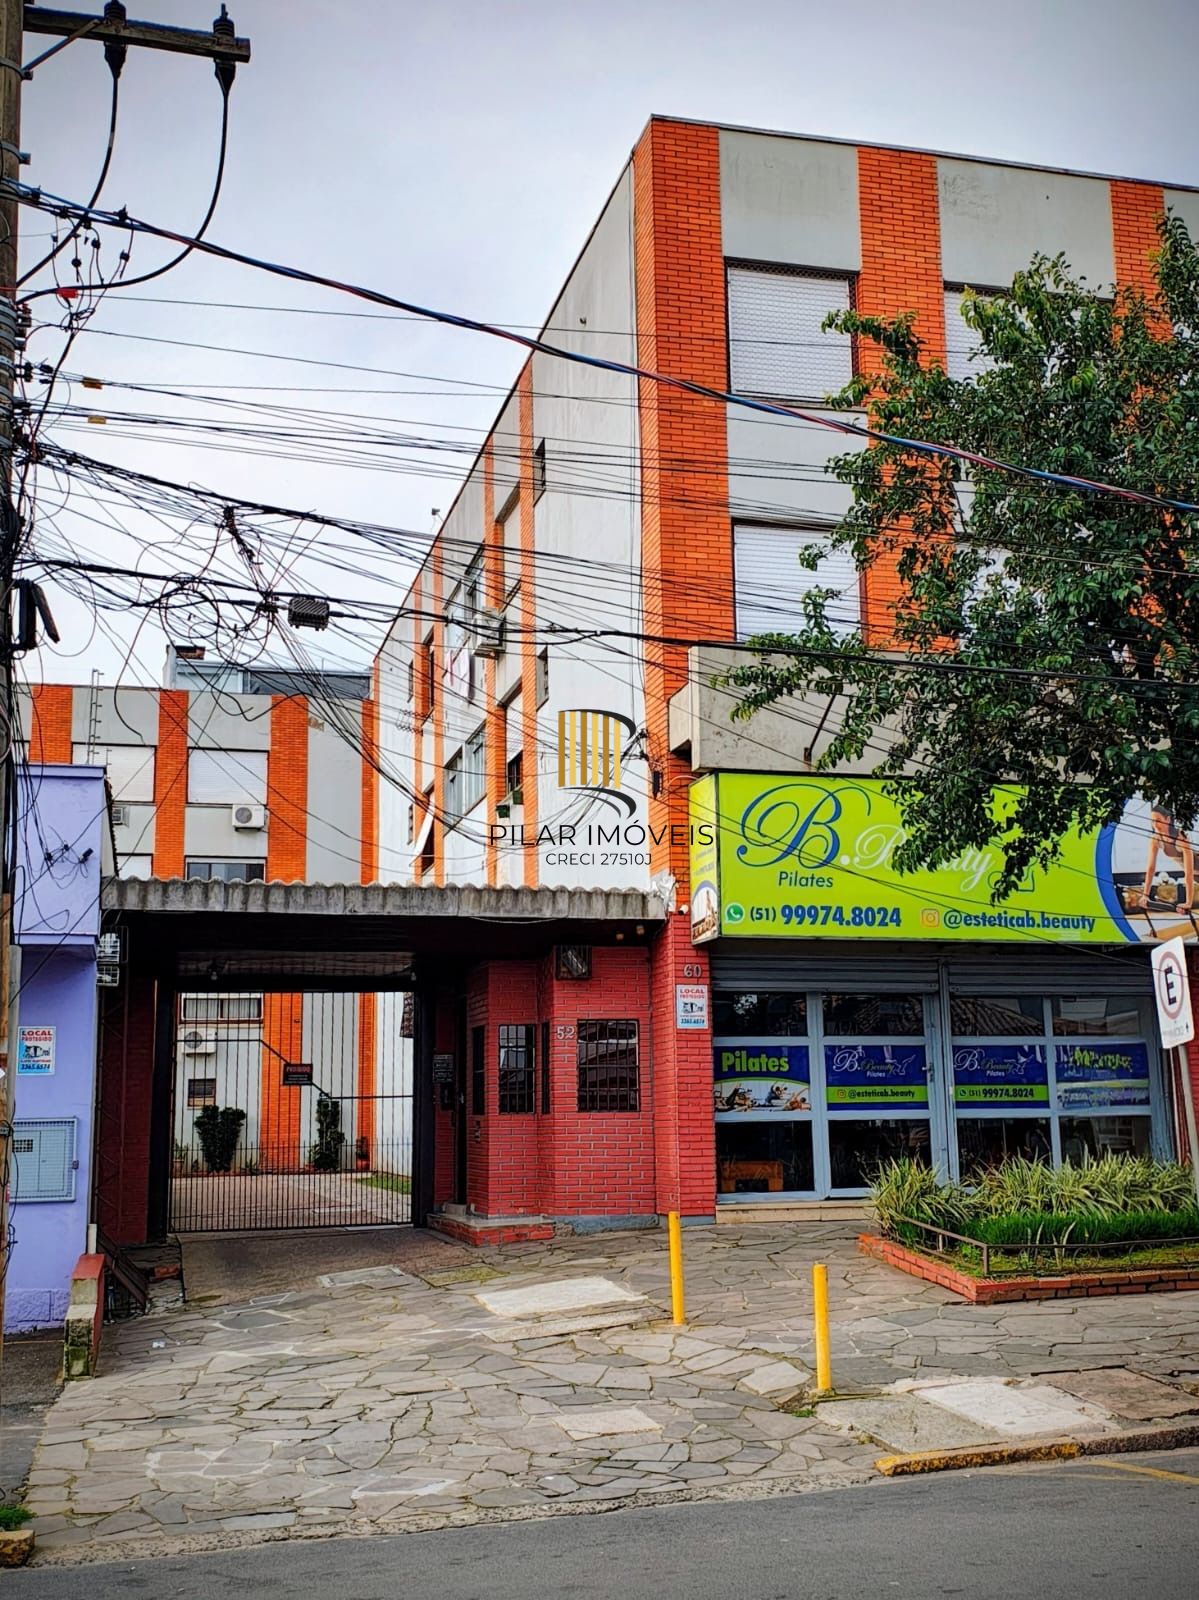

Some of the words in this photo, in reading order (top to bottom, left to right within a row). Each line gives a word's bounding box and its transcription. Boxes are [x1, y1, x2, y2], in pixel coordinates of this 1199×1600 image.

[778, 870, 834, 888] Pilates
[750, 906, 778, 922] (51)
[780, 904, 902, 927] 99974.8024
[943, 908, 1096, 933] @esteticab.beauty
[683, 963, 702, 978] 60
[1164, 966, 1177, 1006] E
[556, 1025, 575, 1039] 52
[721, 1050, 790, 1072] Pilates
[866, 1070, 886, 1078] Pilates
[982, 1087, 1035, 1098] 99974.8024
